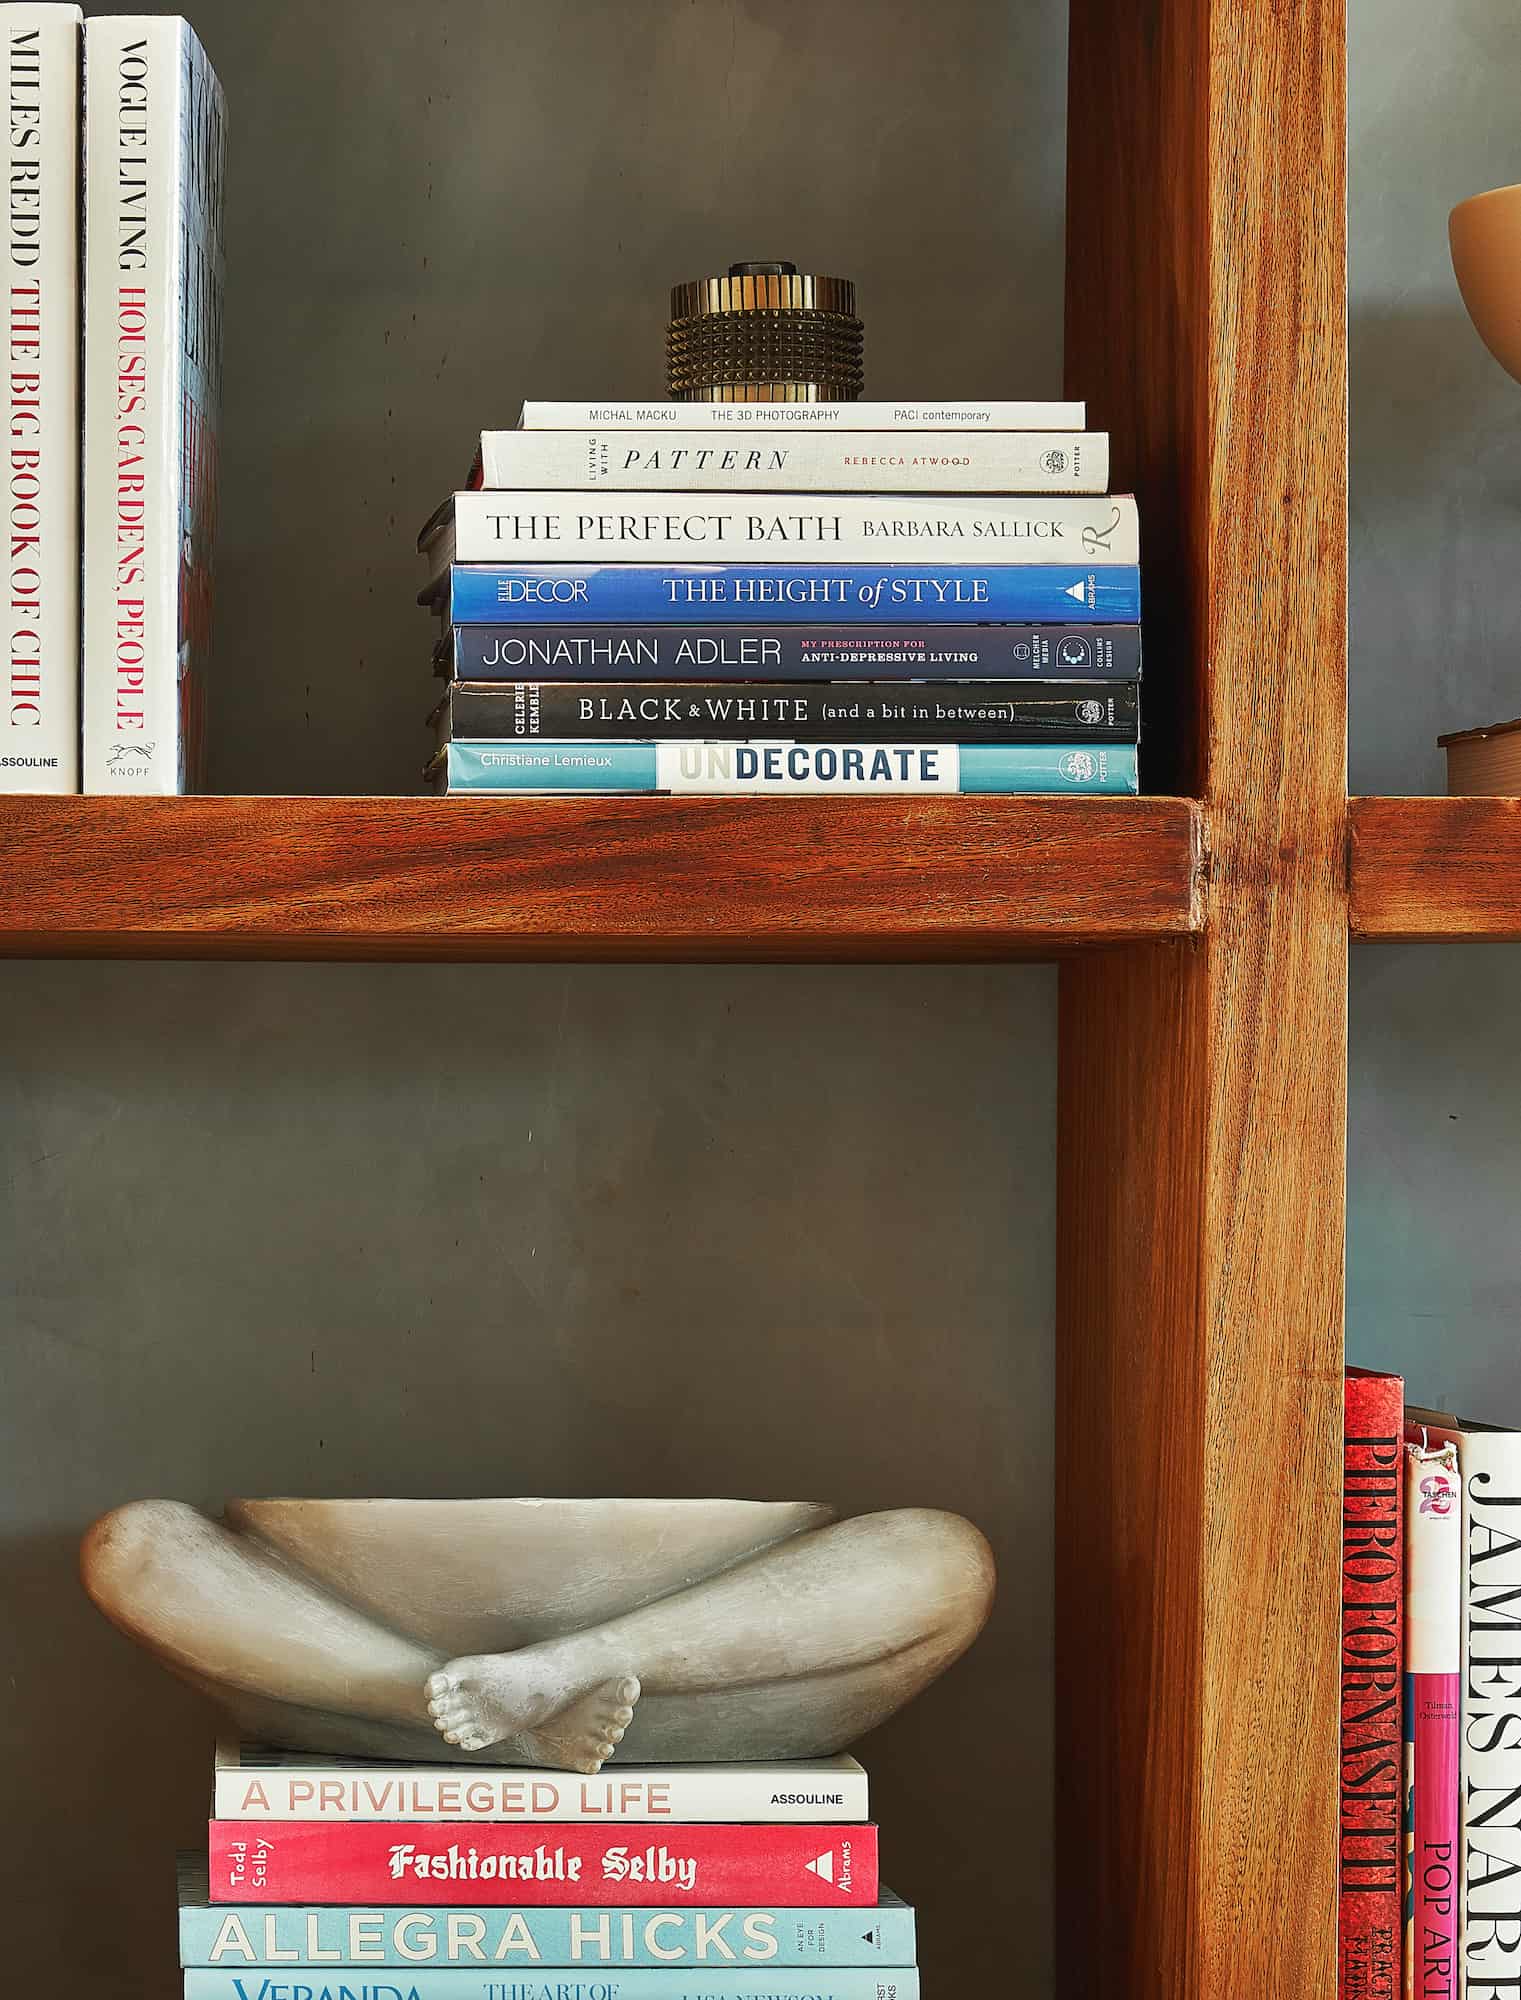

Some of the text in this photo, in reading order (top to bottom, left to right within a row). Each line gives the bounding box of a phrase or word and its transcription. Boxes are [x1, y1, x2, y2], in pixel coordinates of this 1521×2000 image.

[9, 27, 41, 727] MILES REDD THE BIG BOOK OF CHIC
[112, 40, 147, 729] VOGUE LIVING HOUSES, GARDENS, PEOPLE
[589, 410, 991, 422] MICHAL MACKU THE 3D PHOTOGRAPHY PACI contemporary
[588, 439, 596, 480] LIVING
[621, 450, 971, 469] PATTERN REBECCA ATWOOD
[486, 515, 1064, 541] THE PERFECT BATH BARBARA SALLICK
[509, 578, 989, 608] DECOR THE HEIGHT of STYLE
[1088, 574, 1096, 610] ABRAMS
[483, 639, 781, 665] JONATHAN ADLER
[801, 640, 925, 649] MY PRESCRIPTION FOR
[801, 652, 978, 663] ANTI-DEPRESSIVE LIVING
[515, 683, 525, 735] CELERIE
[529, 683, 540, 734] KEMBLE
[579, 698, 1015, 722] BLACK & WHITE (and a bit in between)
[0, 756, 58, 767] SSOULINE
[110, 768, 150, 777] KNOPF
[480, 754, 612, 767] Christiane Lemieux
[679, 747, 939, 781] UNDECORATE
[1343, 1436, 1397, 1583] PIERO
[1465, 1473, 1521, 1752] JAMES
[241, 1780, 672, 1814] A PRIVILEGED LIFE
[770, 1793, 843, 1804] ASSOULINE
[228, 1842, 248, 1885] Todd
[252, 1838, 274, 1887] Selby
[388, 1844, 698, 1890] Fashionable Selby
[838, 1841, 852, 1893] Abrams
[208, 1912, 779, 1961] ALLEGRA HICKS
[1424, 1840, 1451, 2000] POP ART
[797, 1938, 804, 1952] AN
